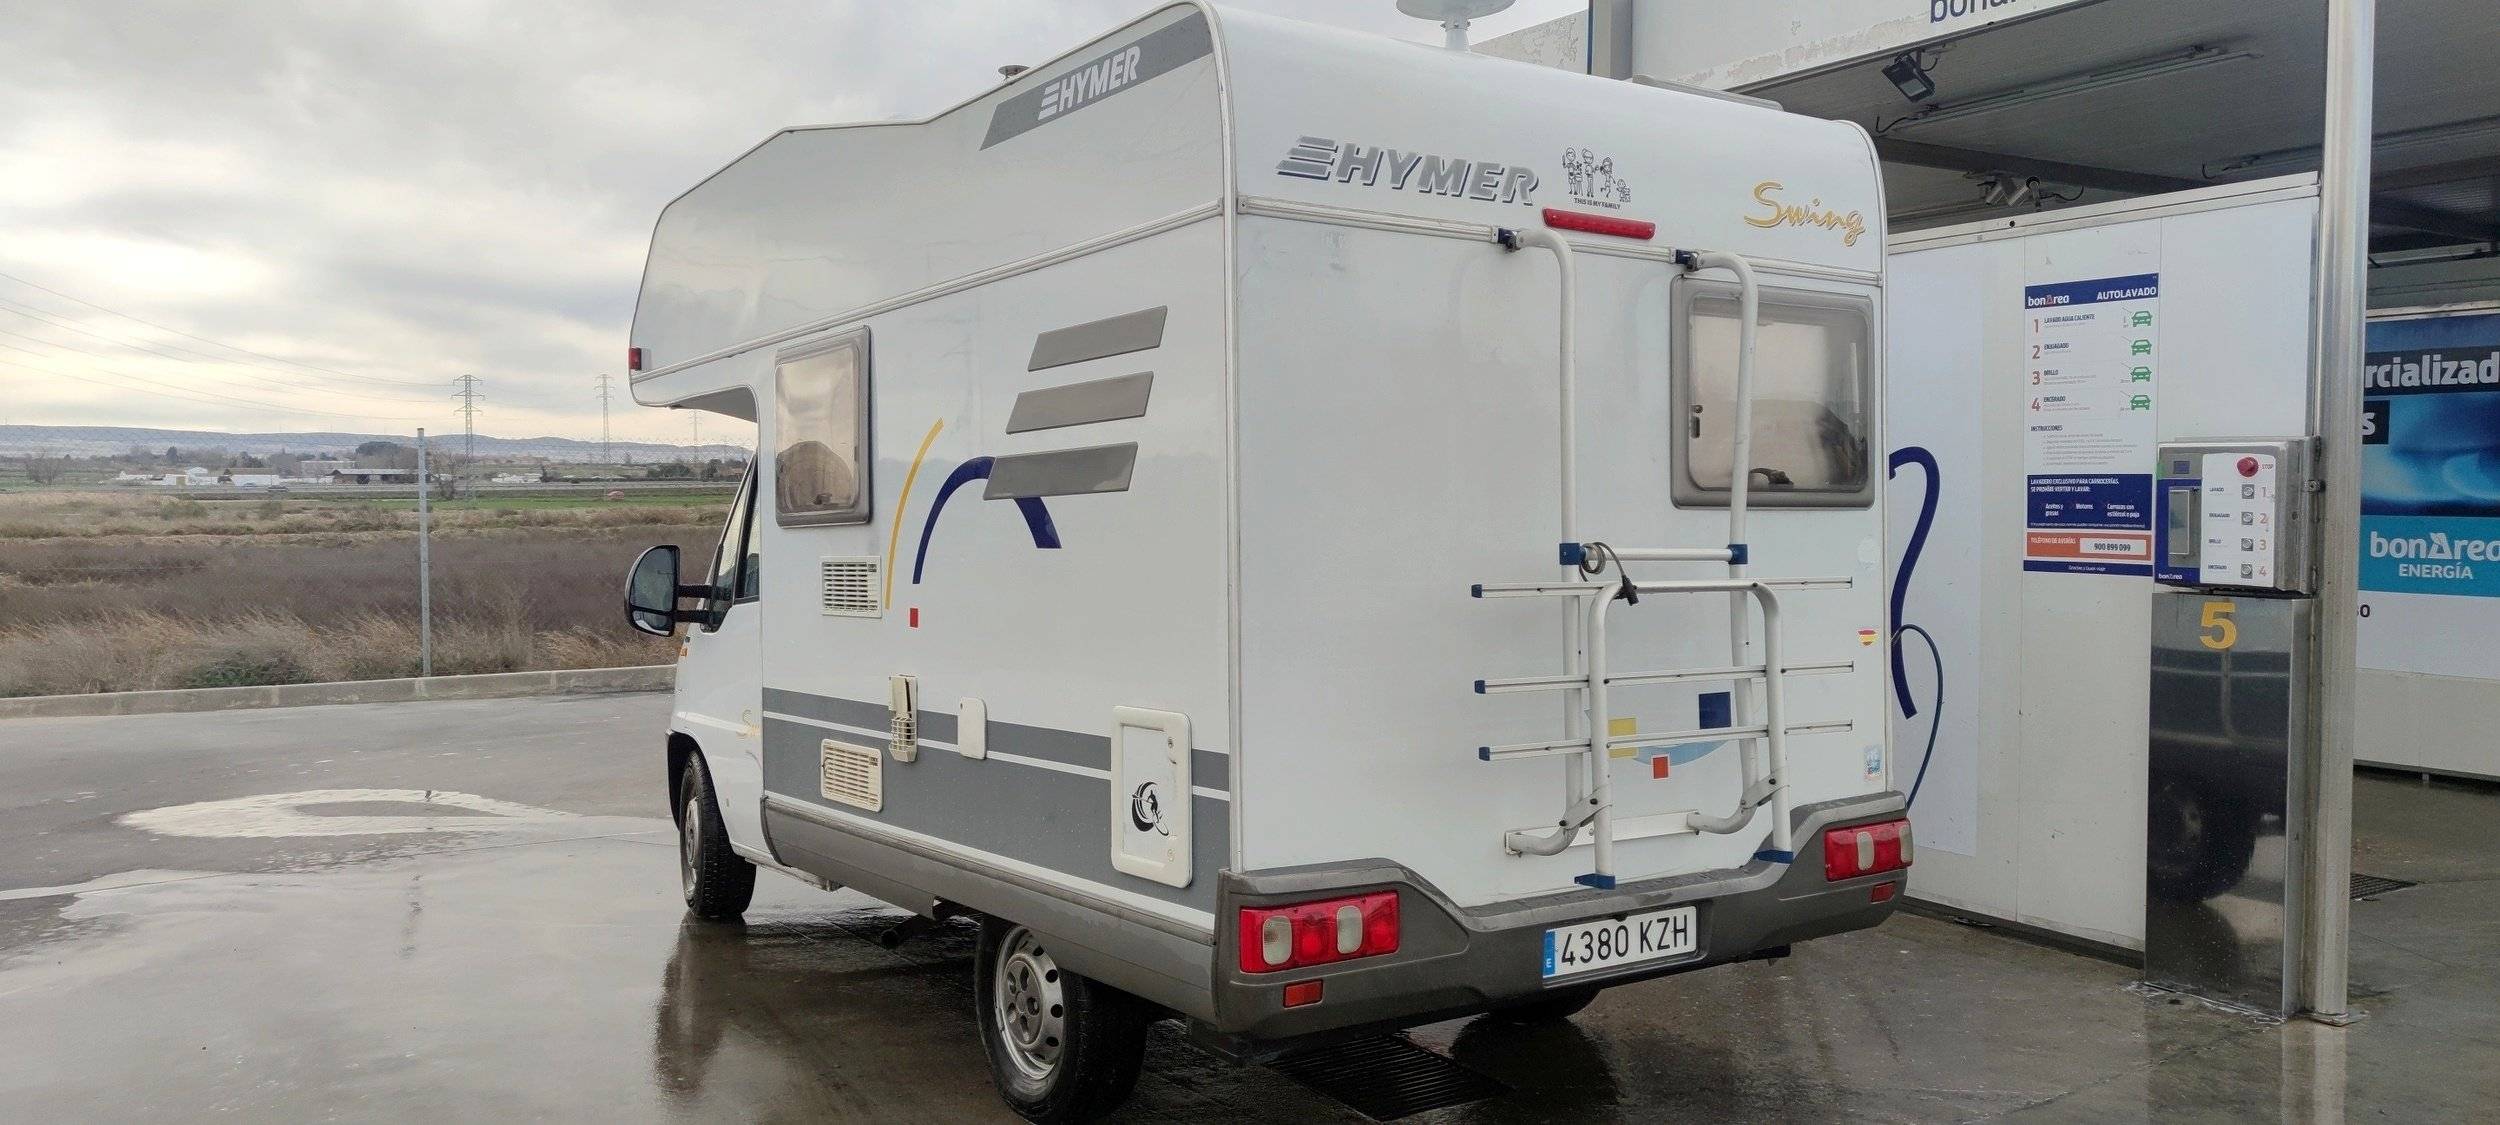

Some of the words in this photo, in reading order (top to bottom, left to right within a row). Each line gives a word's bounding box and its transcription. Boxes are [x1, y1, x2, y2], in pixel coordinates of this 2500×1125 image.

[1573, 197, 1586, 205] THIS
[1602, 202, 1620, 210] FAMILY
[1743, 181, 1866, 247] Swing
[2096, 286, 2157, 301] AUTOLAVADO
[2034, 318, 2039, 334] 1
[2032, 344, 2041, 360] 2
[2032, 370, 2041, 385] 3
[2031, 397, 2041, 411] 4
[2030, 424, 2064, 432] INSTRUCCIONES
[2261, 486, 2267, 498] 1
[2259, 512, 2268, 525] 2
[2094, 543, 2106, 551] 900
[2259, 539, 2267, 551] 3
[2258, 565, 2267, 577] 4
[2398, 562, 2474, 579] ENERGÍA
[2200, 601, 2238, 650] 5
[1561, 924, 1629, 967] 4380
[1639, 914, 1688, 953] KZH
[1544, 958, 1552, 968] E
